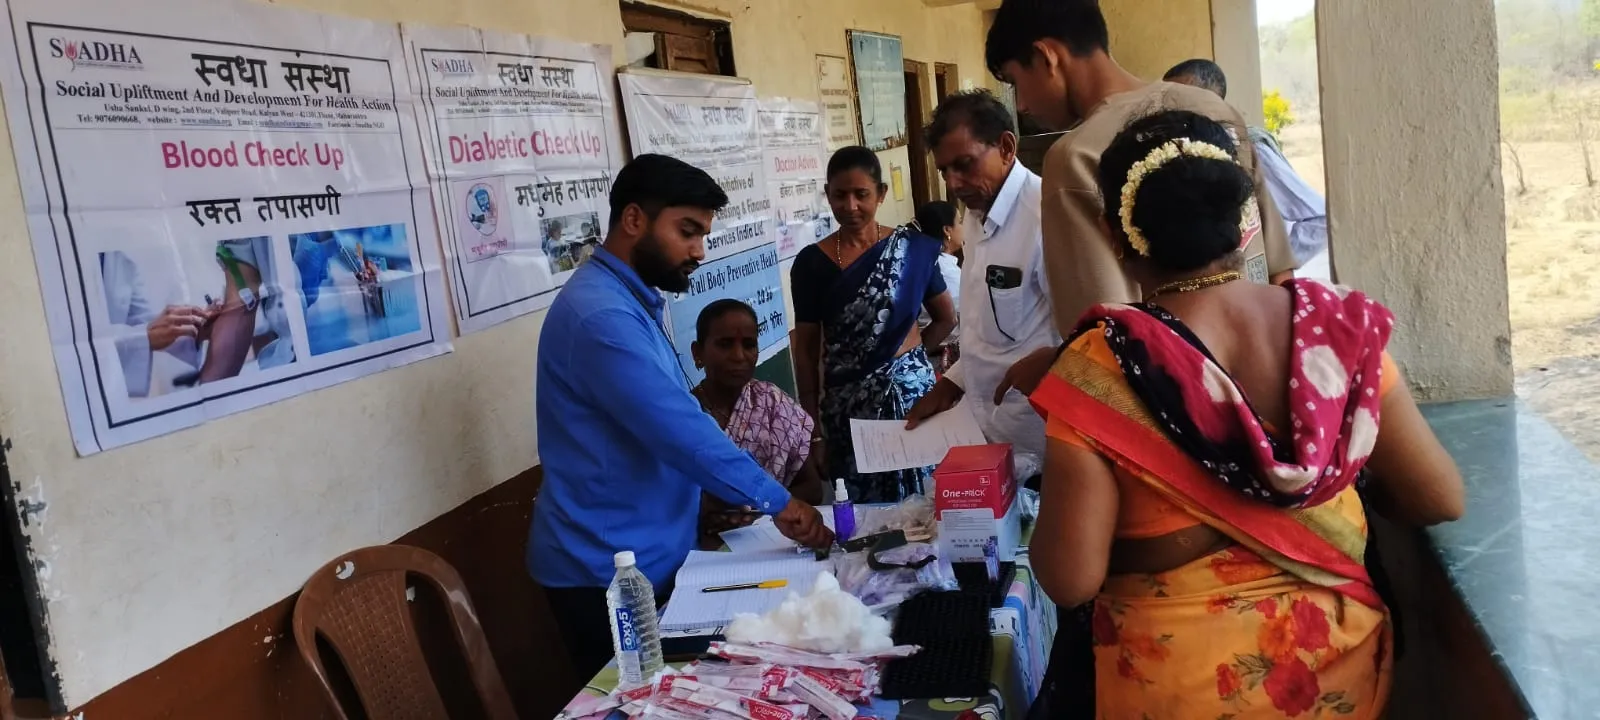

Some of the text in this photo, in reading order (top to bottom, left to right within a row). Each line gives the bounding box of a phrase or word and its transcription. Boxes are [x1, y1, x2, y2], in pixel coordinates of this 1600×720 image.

[191, 51, 350, 93] स्वधा संस्था
[498, 62, 534, 86] स्वधा
[56, 80, 392, 111] Social Upliftment And Development For Health Action
[435, 86, 458, 98] Social
[161, 140, 345, 170] Blood Check Up
[448, 128, 601, 164] Diabetic Check Up
[774, 156, 797, 172] Doctor
[186, 184, 342, 227] रक्त तपासणी
[514, 170, 611, 217] मधुमेह तपासणी
[707, 230, 736, 250] Services
[736, 224, 754, 243] India
[690, 273, 706, 297] Full
[707, 269, 727, 290] Body
[727, 258, 760, 283] Preventive
